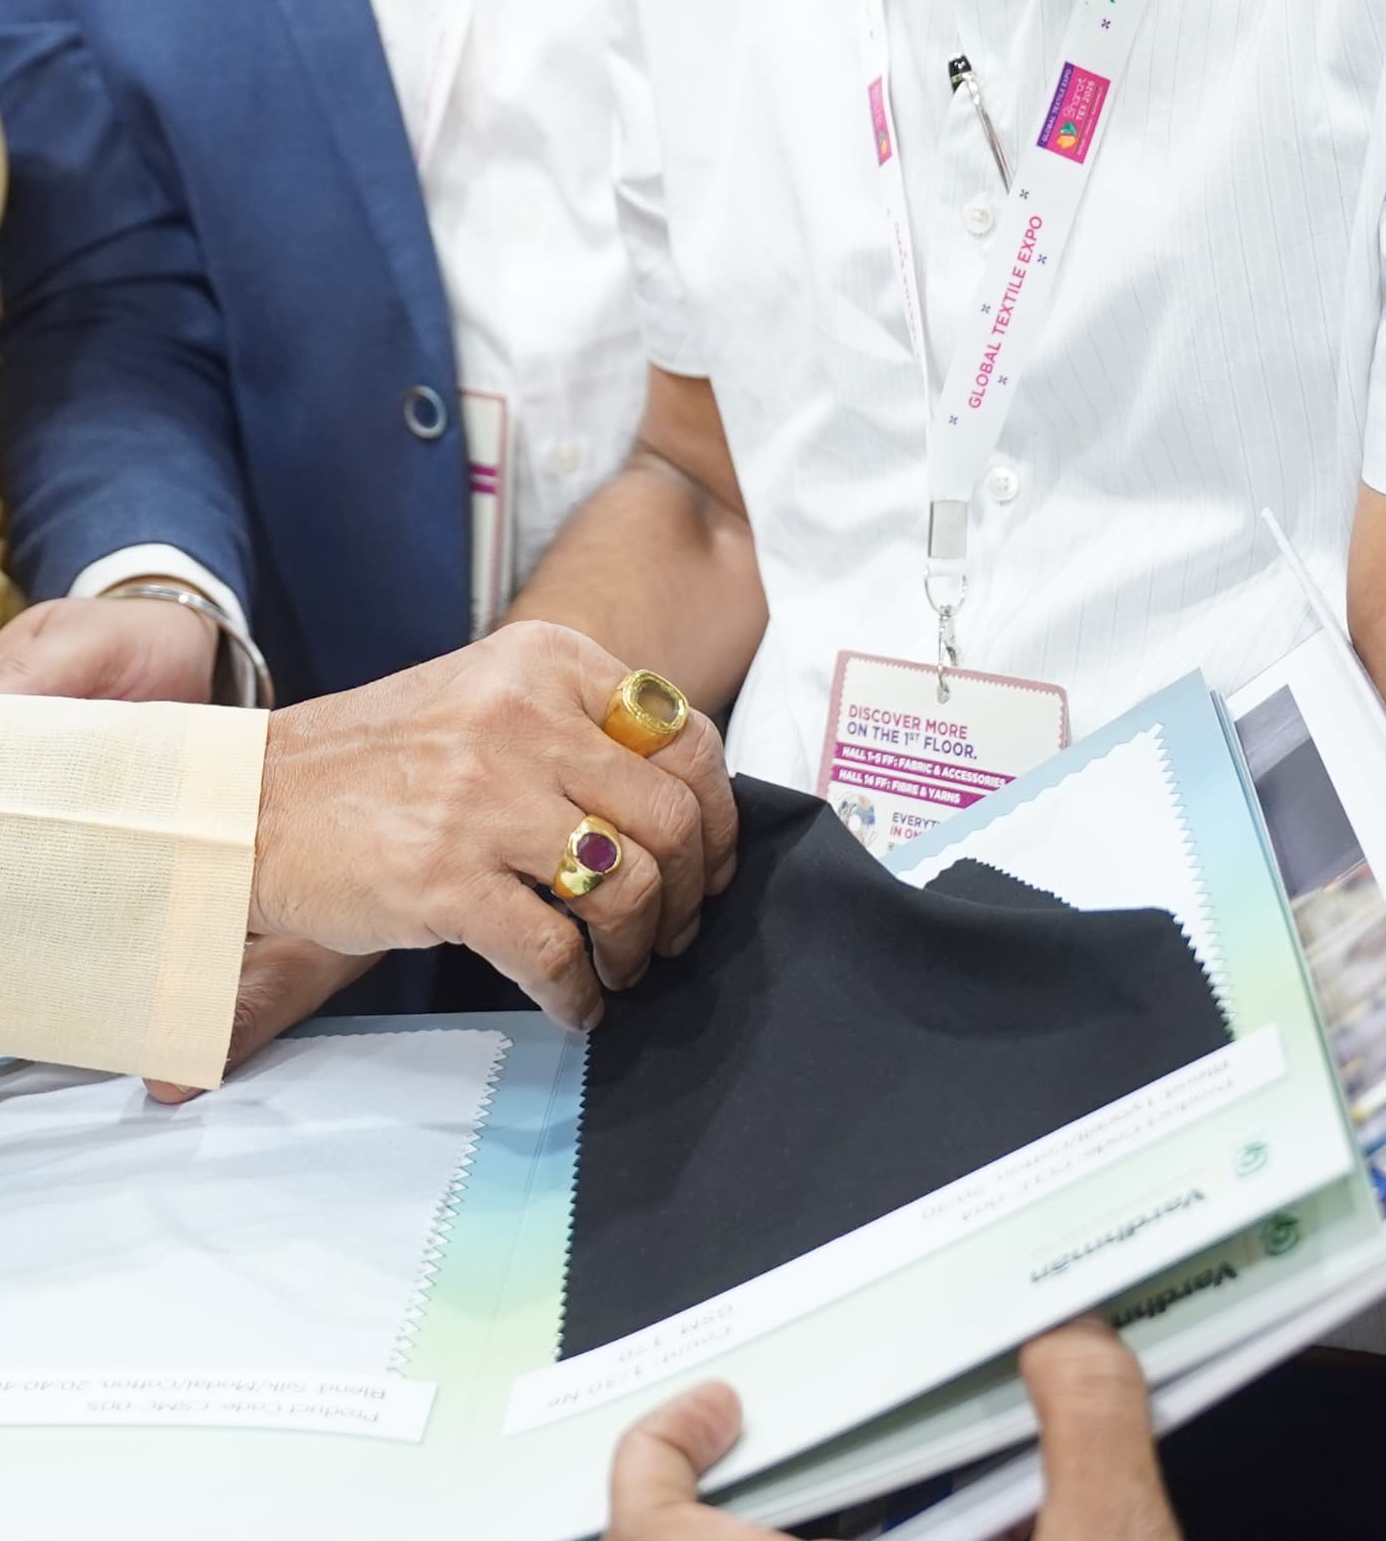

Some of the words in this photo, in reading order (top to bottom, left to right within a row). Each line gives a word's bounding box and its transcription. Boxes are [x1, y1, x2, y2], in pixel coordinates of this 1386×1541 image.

[968, 342, 1001, 410] GLOBAL
[991, 263, 1030, 337] TEXTILE
[1017, 215, 1043, 264] EXPO
[847, 704, 921, 731] DISCOVER
[925, 719, 968, 740] MORE
[846, 721, 868, 738] ON
[872, 725, 900, 744] THE
[923, 737, 978, 761] FLOOR.
[841, 746, 866, 762] HALL
[898, 758, 933, 776] FABRIC
[838, 769, 863, 784] HALL
[927, 787, 961, 805] YARNS
[892, 812, 941, 829] EVERYT
[1106, 1260, 1238, 1335] Vardhm
[288, 1403, 379, 1423] Product
